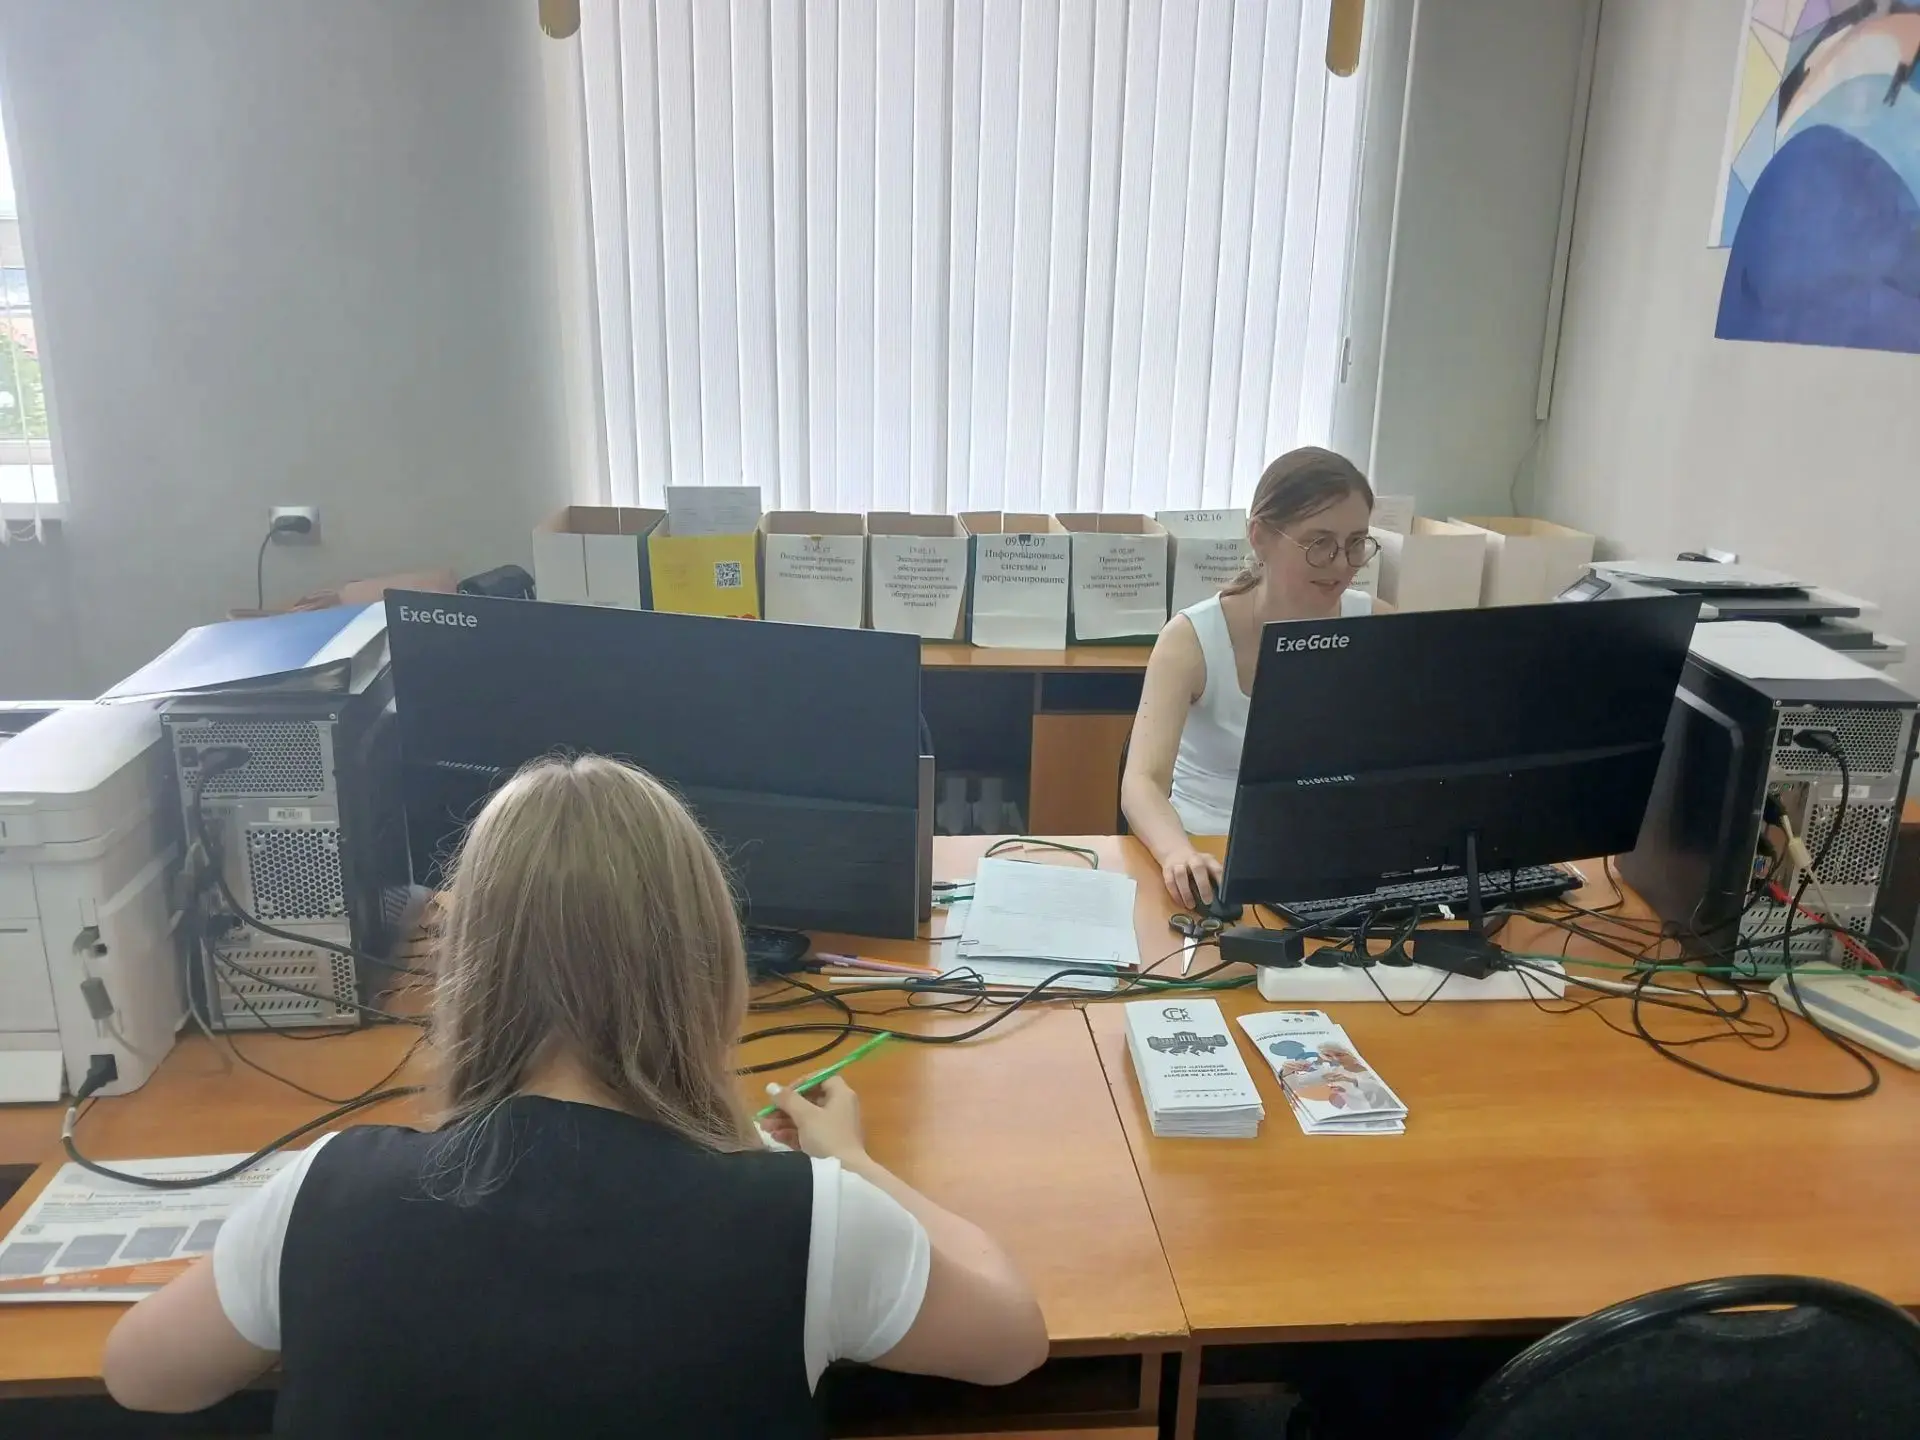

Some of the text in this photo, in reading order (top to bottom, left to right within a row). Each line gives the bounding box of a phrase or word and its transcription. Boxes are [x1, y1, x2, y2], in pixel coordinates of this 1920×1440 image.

[984, 549, 1065, 561] Информационные
[1000, 563, 1039, 571] системы
[982, 574, 1065, 584] программирование
[399, 605, 478, 628] ExeGate
[1276, 633, 1350, 653] ExeGate
